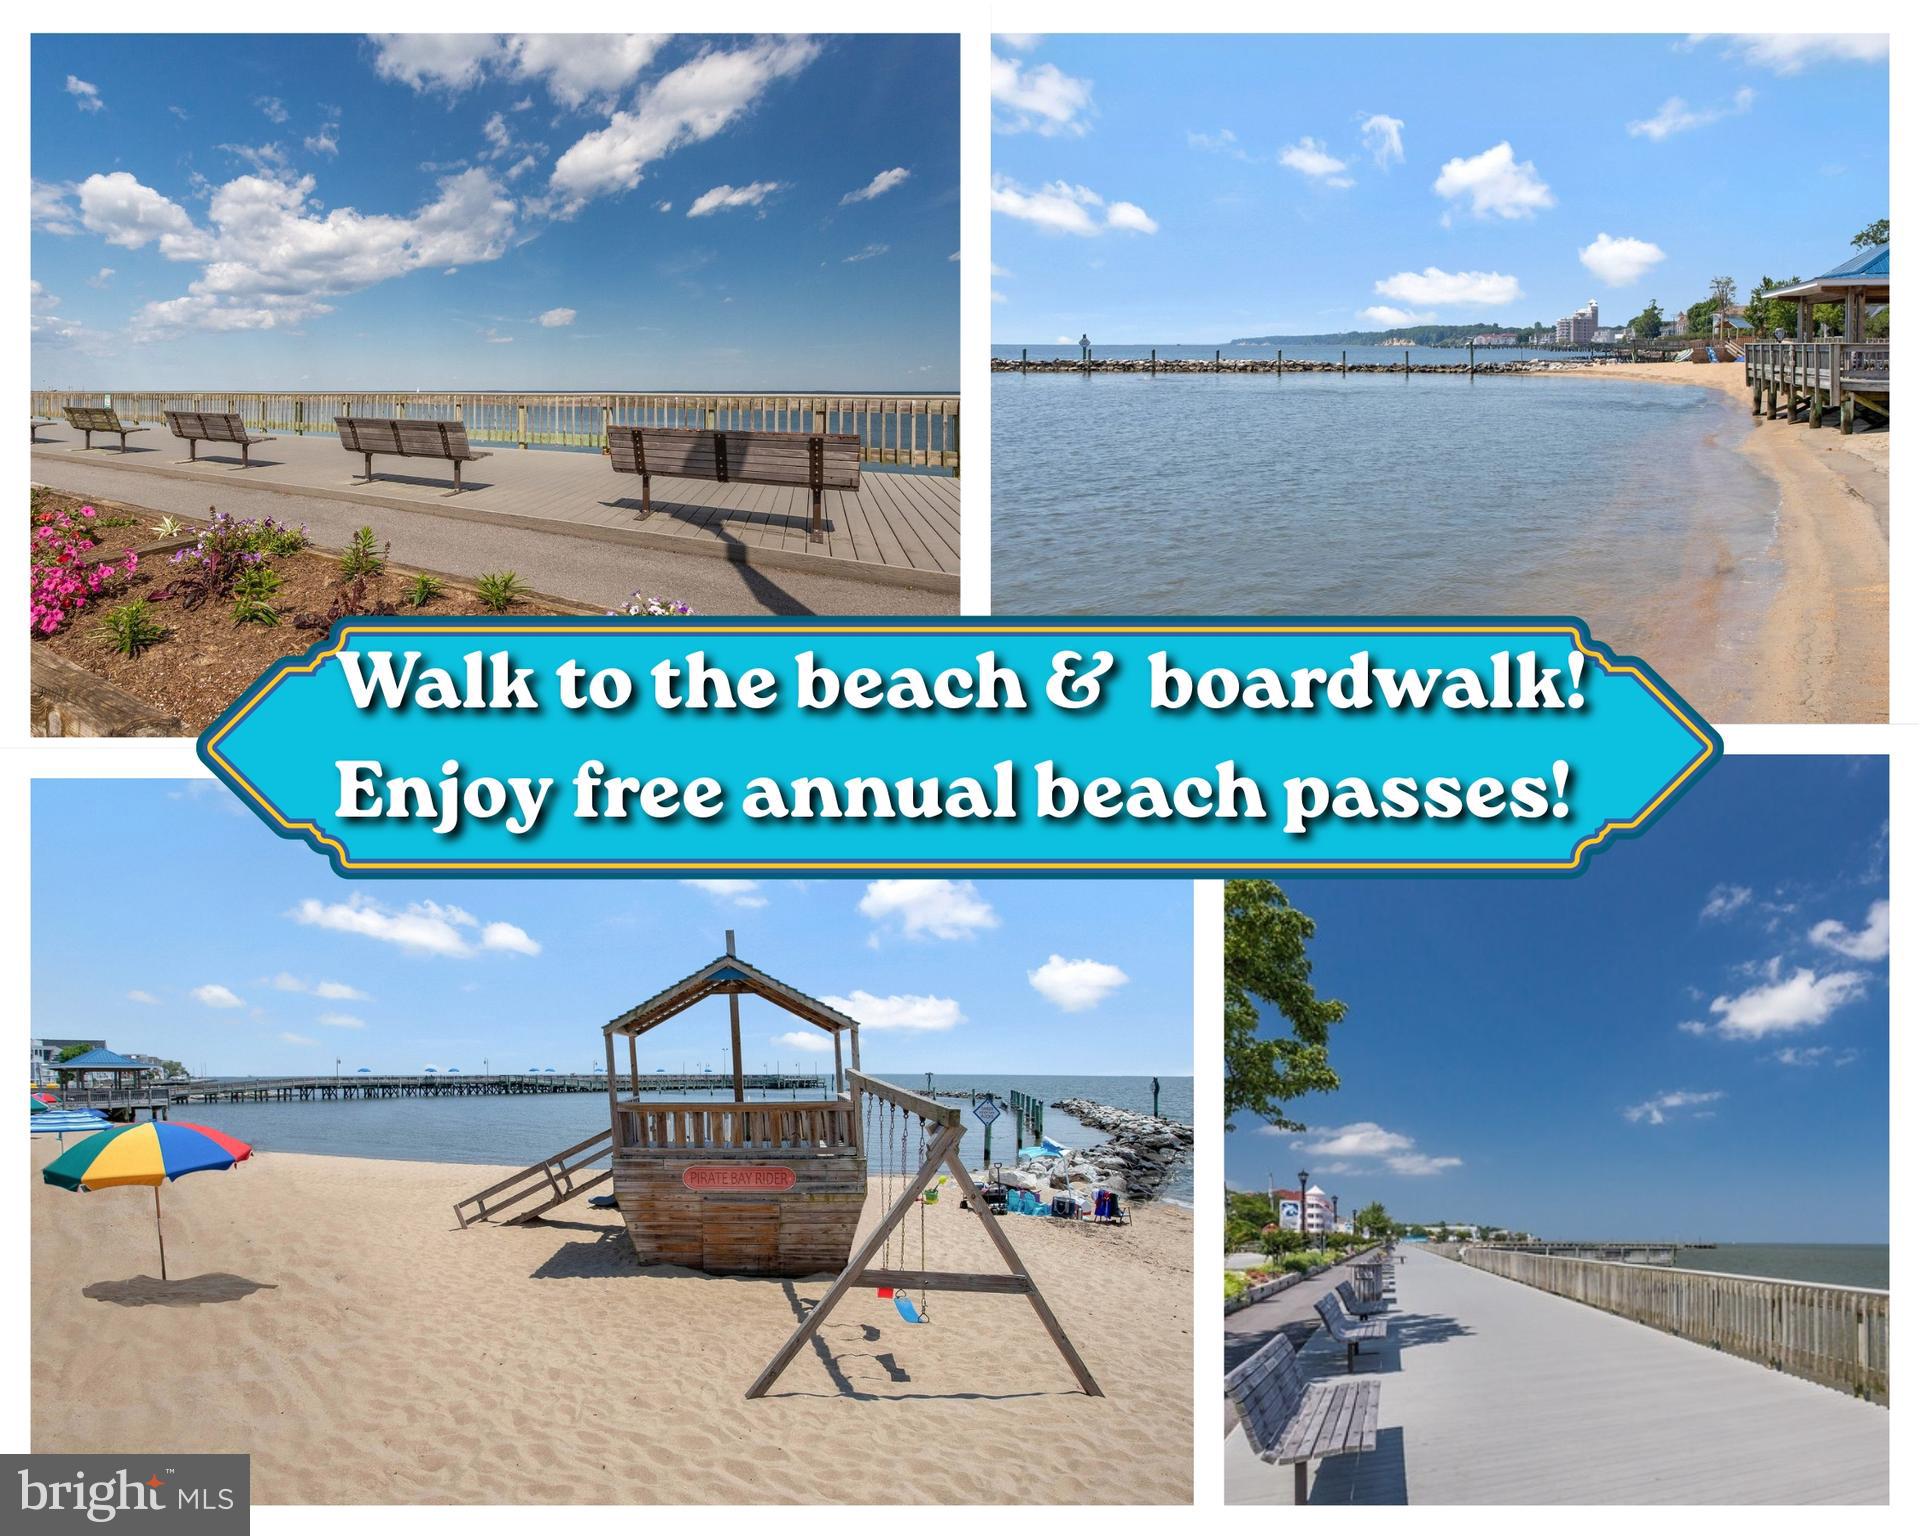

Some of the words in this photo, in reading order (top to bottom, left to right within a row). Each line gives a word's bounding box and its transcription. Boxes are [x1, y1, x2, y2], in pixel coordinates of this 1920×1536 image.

[690, 1171, 728, 1185] PIRATE
[731, 1171, 753, 1185] BAY
[755, 1172, 788, 1185] RIDER
